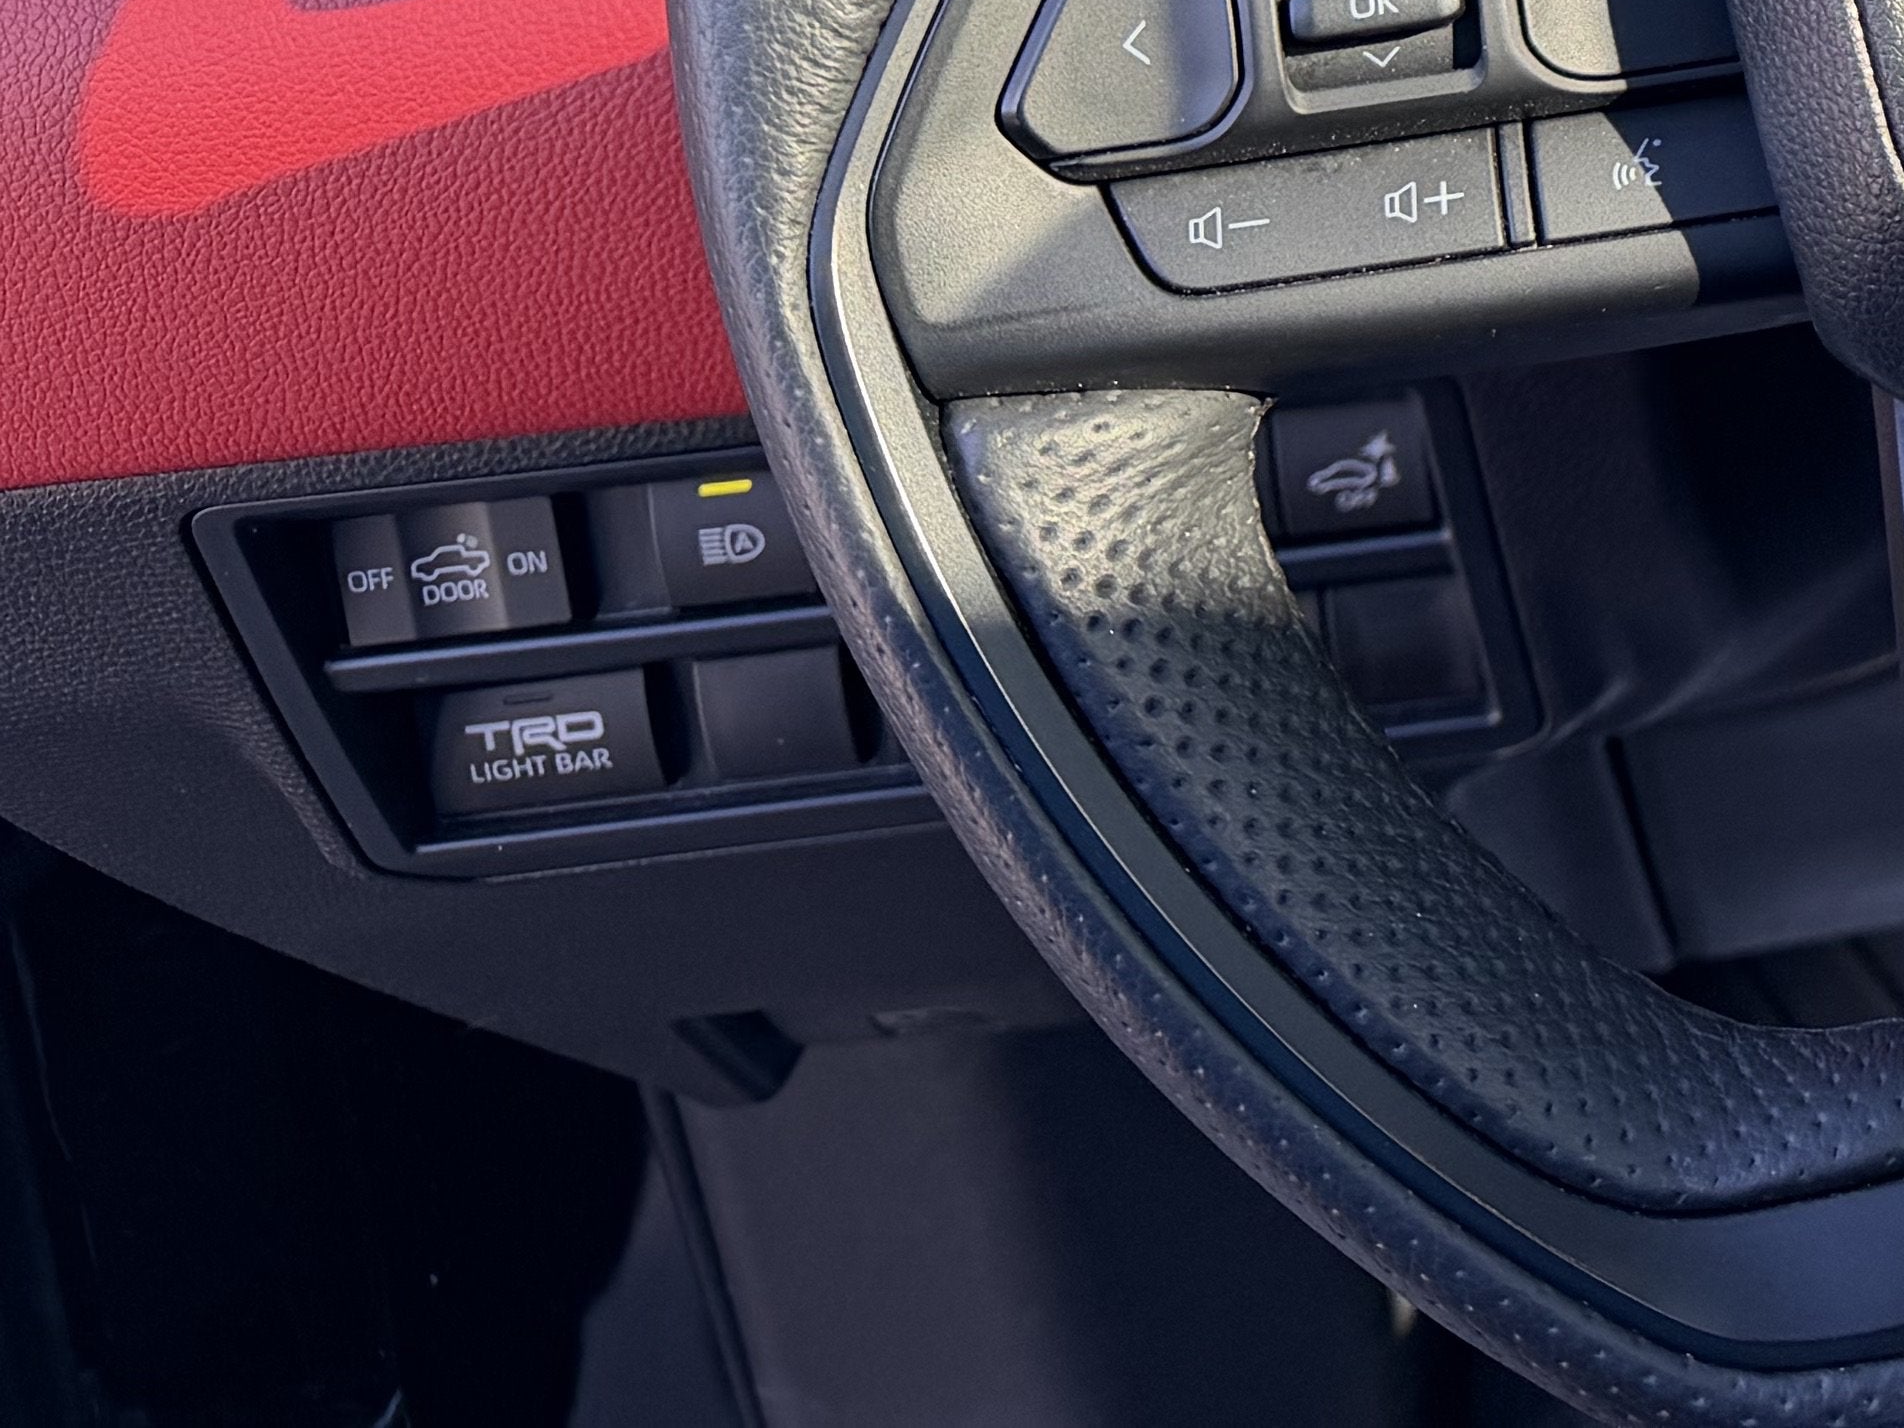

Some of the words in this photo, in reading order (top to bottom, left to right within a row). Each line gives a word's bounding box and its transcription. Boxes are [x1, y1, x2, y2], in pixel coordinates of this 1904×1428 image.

[506, 549, 549, 577] ON
[347, 567, 394, 594] OFF
[422, 578, 490, 607] DOOR
[464, 709, 606, 755] TRD
[469, 754, 547, 785] LIGHT
[554, 746, 613, 776] BAR
